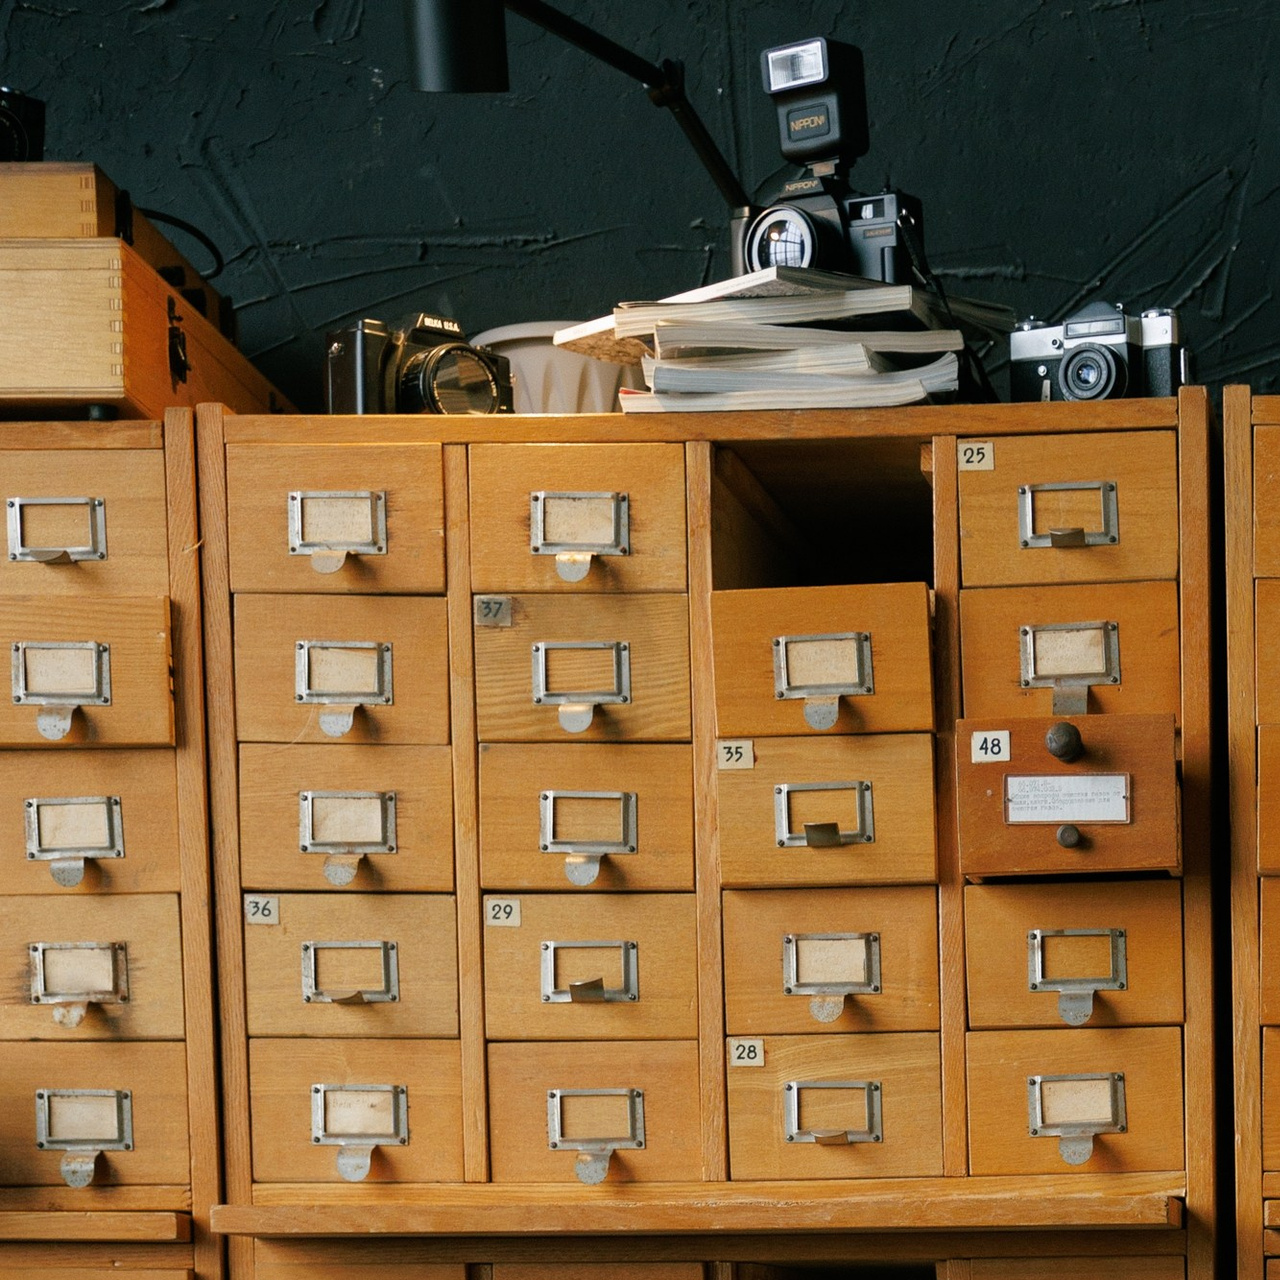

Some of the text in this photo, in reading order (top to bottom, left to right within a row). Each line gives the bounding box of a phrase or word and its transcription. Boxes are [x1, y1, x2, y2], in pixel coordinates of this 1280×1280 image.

[790, 115, 824, 131] NIPPON
[963, 446, 986, 464] 25
[481, 600, 503, 618] 37
[979, 736, 1002, 755] 48
[723, 746, 743, 763] 35
[249, 900, 272, 918] 36
[491, 903, 513, 920] 29
[735, 1043, 758, 1060] 28
